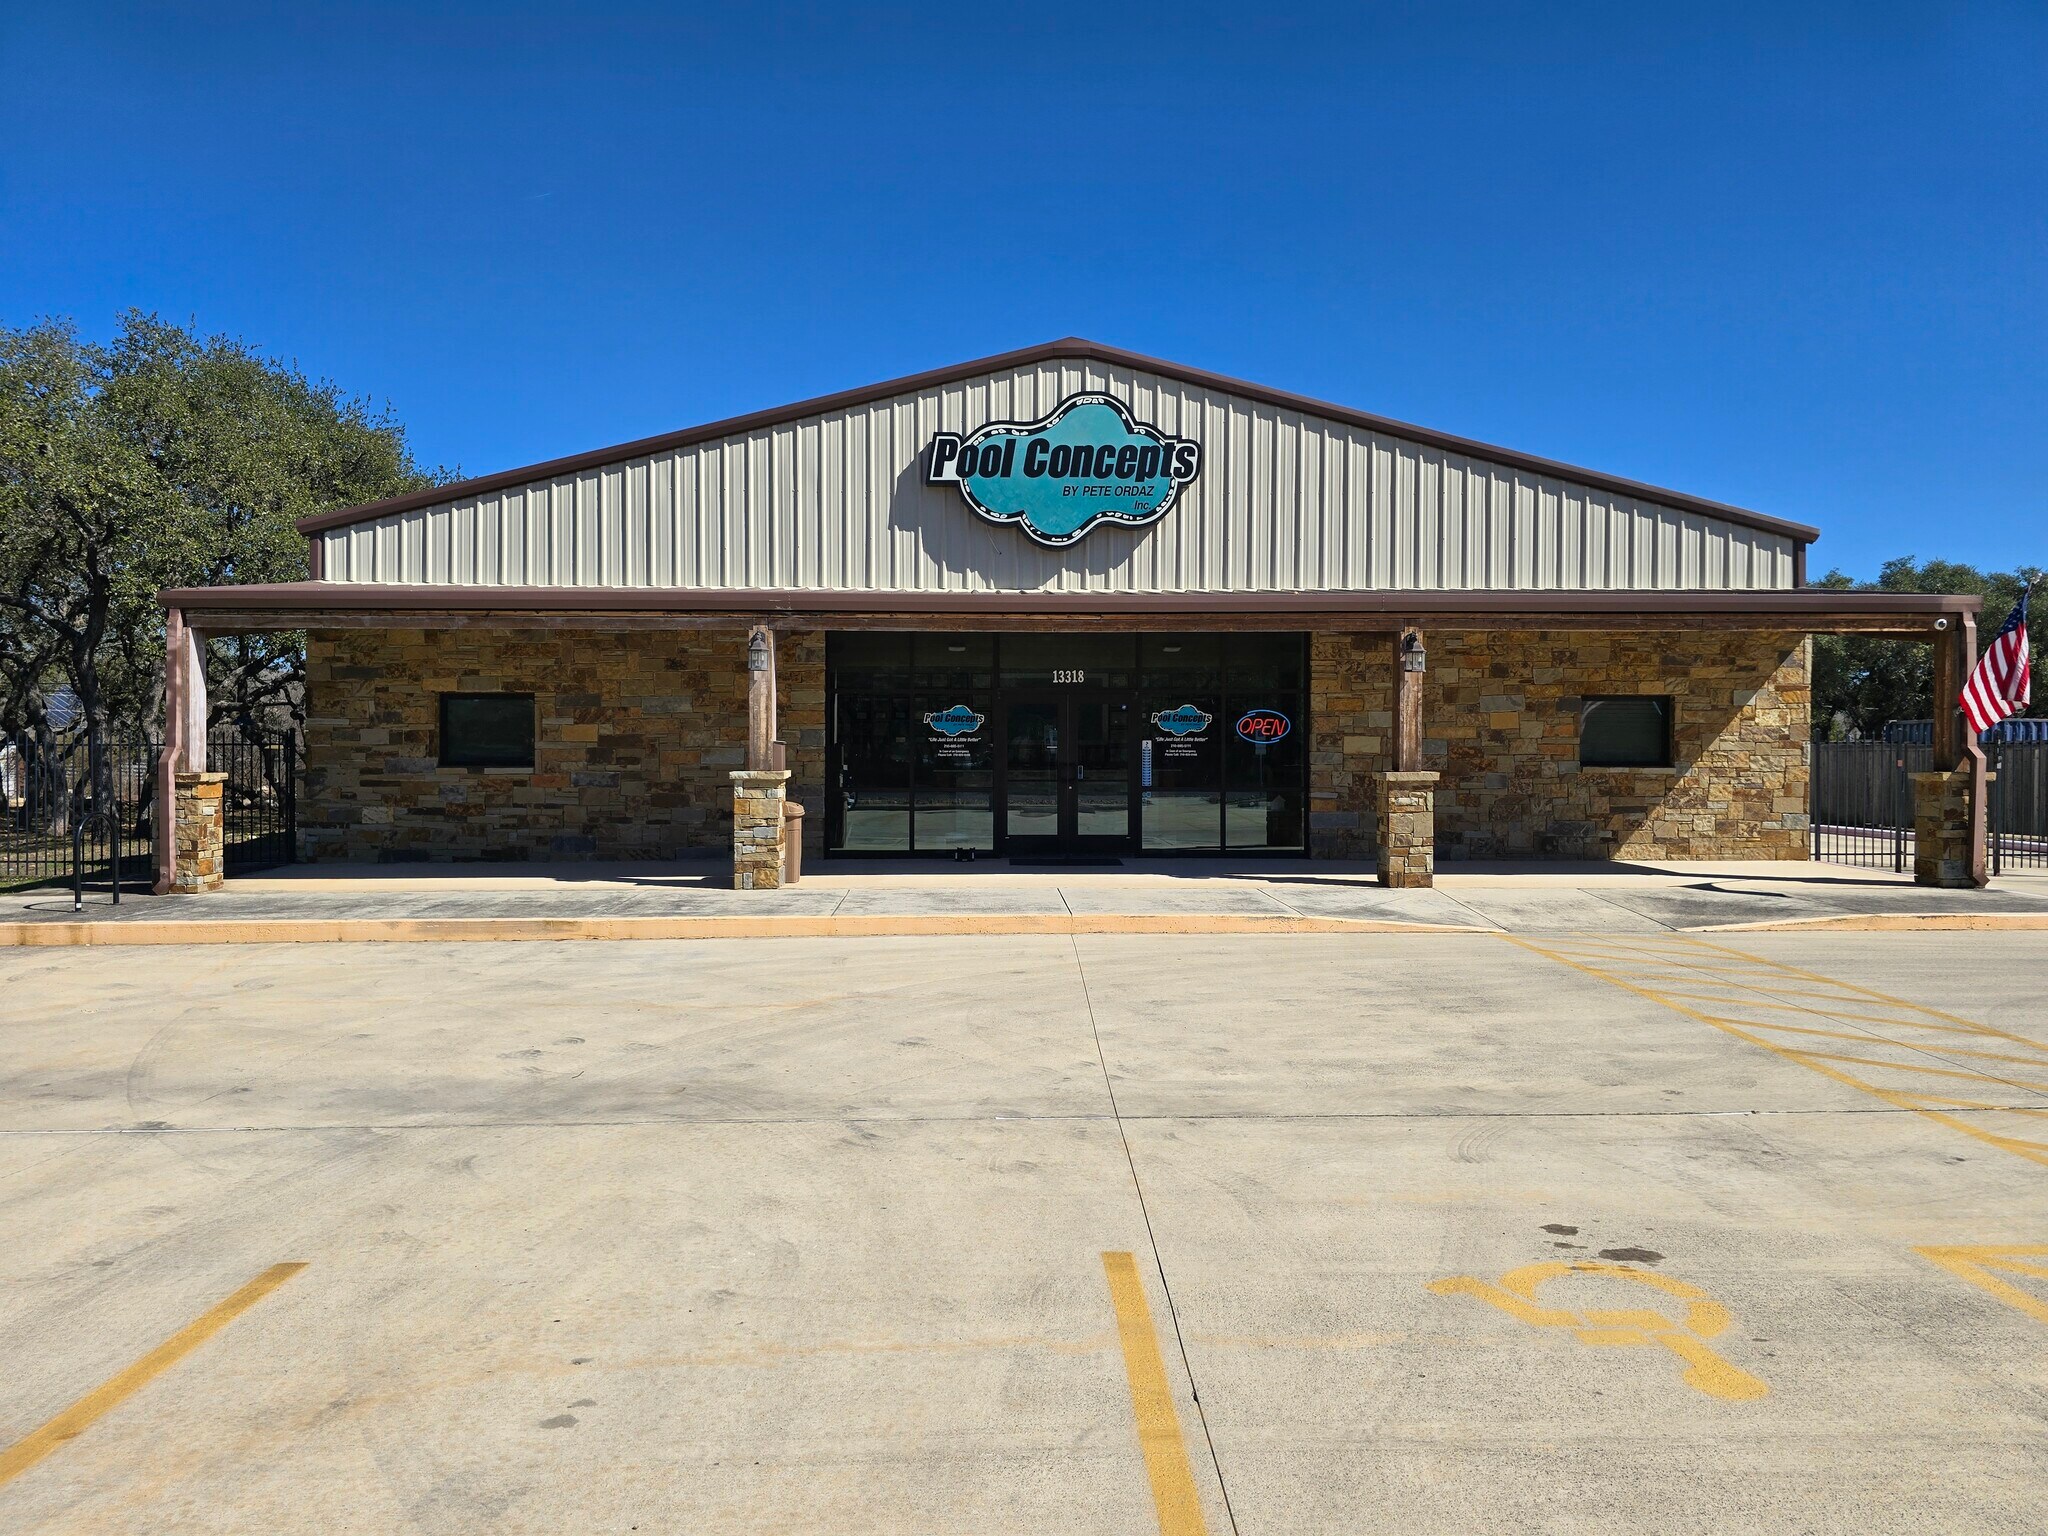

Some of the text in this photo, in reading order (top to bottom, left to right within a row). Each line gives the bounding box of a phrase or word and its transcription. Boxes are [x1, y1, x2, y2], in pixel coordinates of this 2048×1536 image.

[932, 437, 1195, 483] Pool Concepts
[1063, 485, 1155, 497] BY PETE ORDAZ
[1133, 500, 1152, 510] Inc.
[1052, 669, 1085, 684] 13318
[924, 714, 984, 723] Pool Concepts
[1152, 713, 1212, 724] Pool Concepts
[1239, 717, 1287, 736] OPEN
